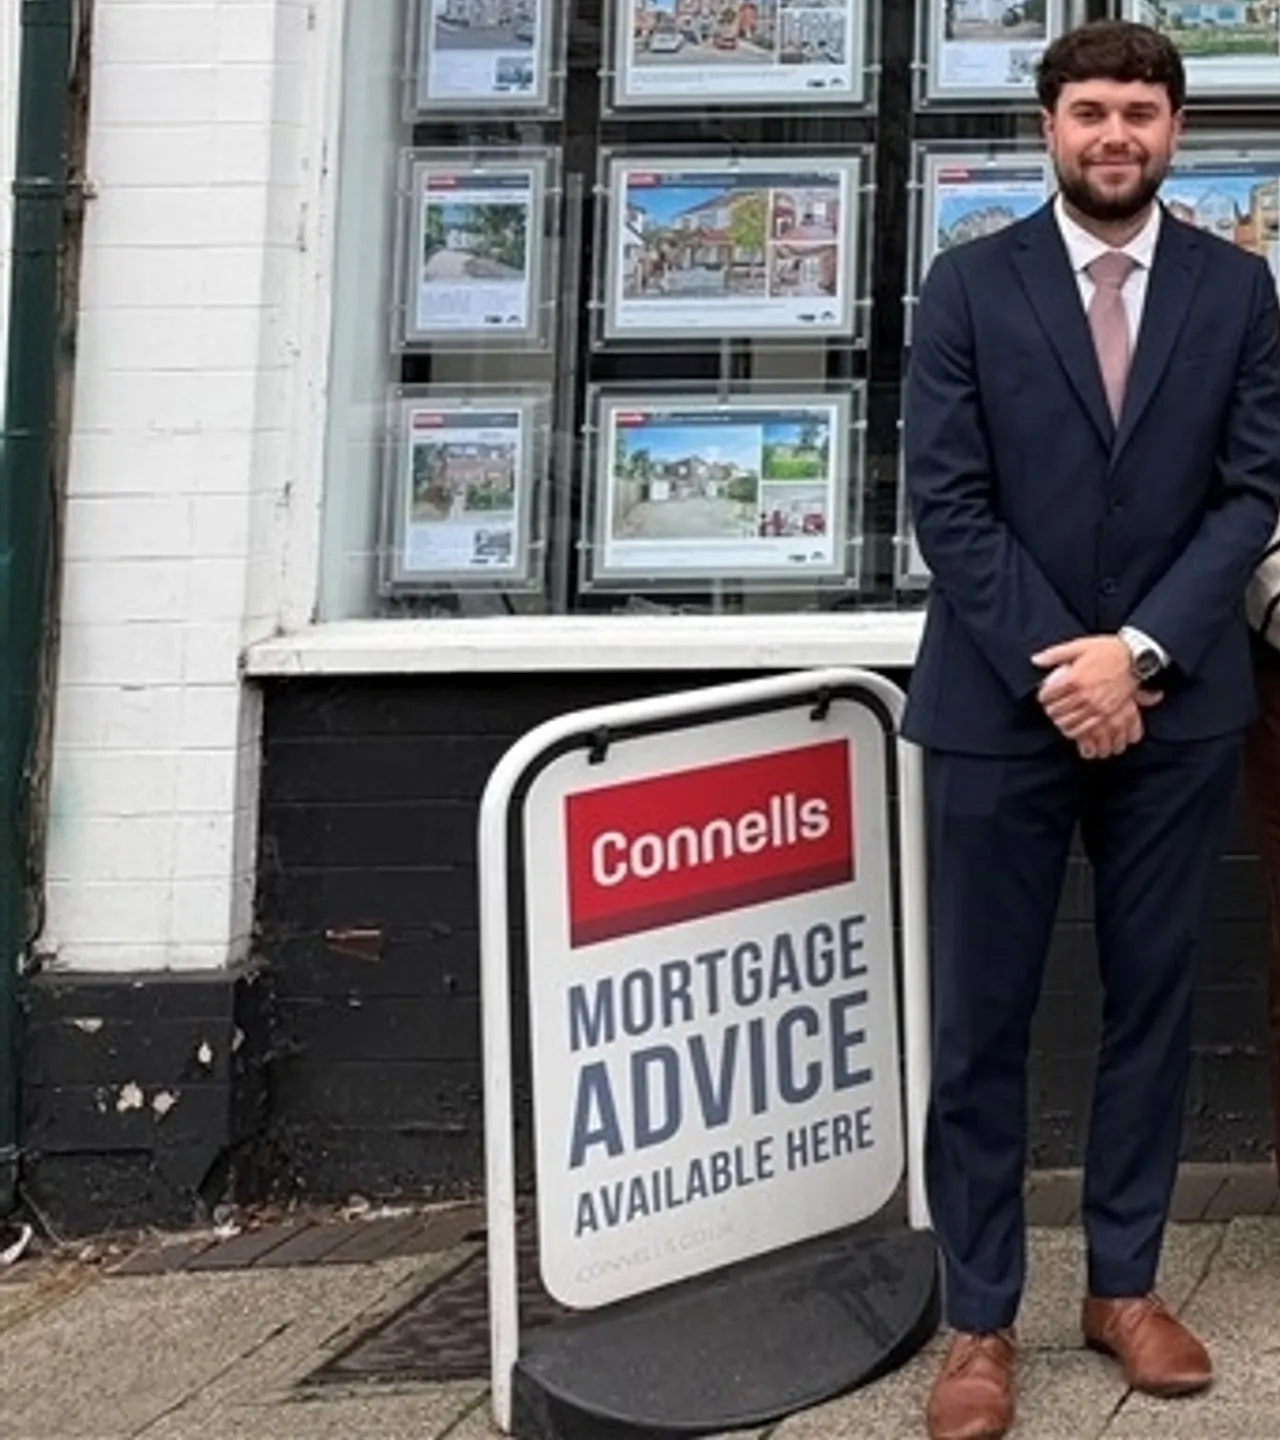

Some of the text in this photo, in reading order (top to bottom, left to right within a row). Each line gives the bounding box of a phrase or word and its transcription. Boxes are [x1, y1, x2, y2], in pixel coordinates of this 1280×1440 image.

[591, 793, 831, 887] Connells
[568, 914, 868, 1053] MORTGAGE
[568, 989, 873, 1170] ADVICE
[574, 1106, 875, 1238] AVAILABLE HERE
